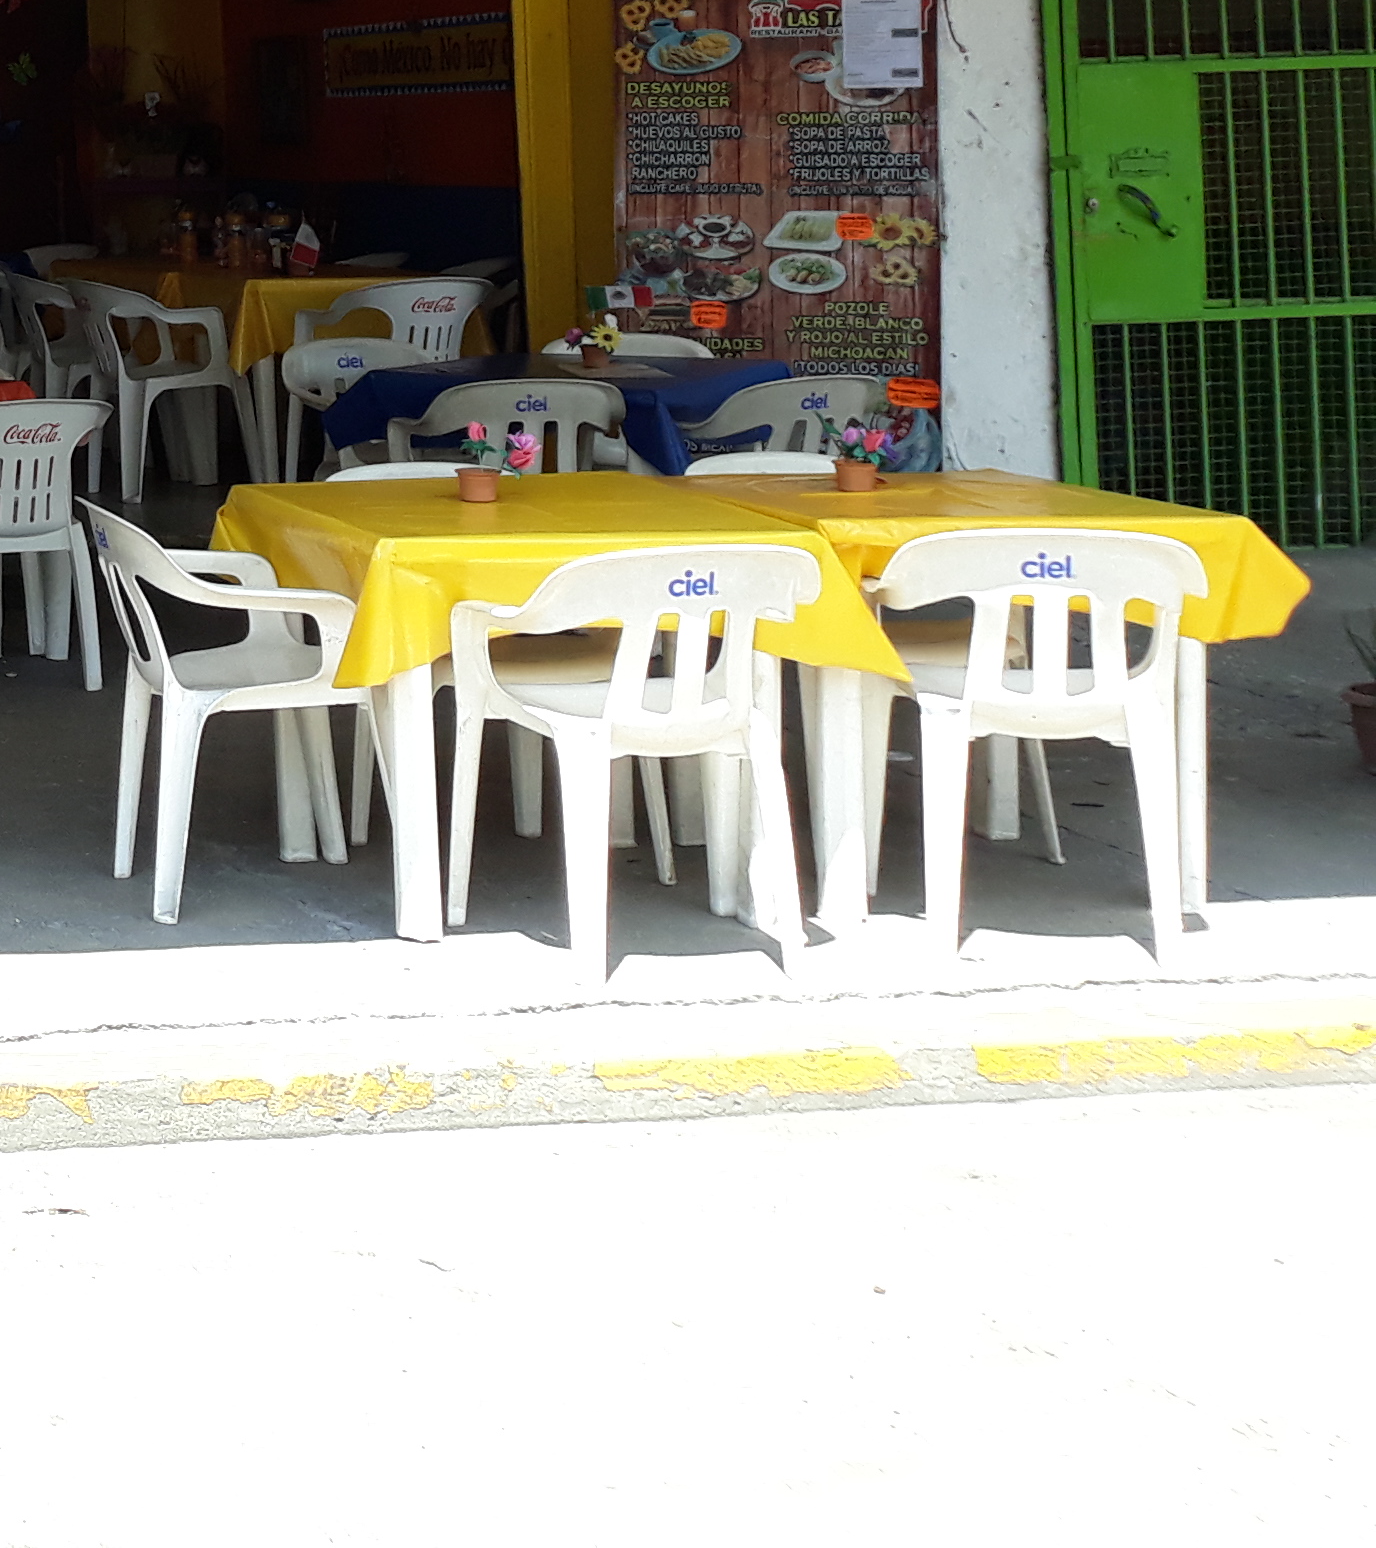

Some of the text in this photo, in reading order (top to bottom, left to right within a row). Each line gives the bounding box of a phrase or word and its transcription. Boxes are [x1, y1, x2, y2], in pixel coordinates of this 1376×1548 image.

[787, 11, 819, 27] LAS
[631, 96, 730, 108] A ESCOGER
[659, 112, 698, 124] CAKES
[777, 112, 923, 124] COMIDA CORRIDA
[683, 126, 697, 138] AL
[700, 126, 741, 138] GUSTO
[828, 127, 845, 139] DE
[848, 127, 886, 139] PASTA
[828, 140, 845, 152] DE
[846, 140, 890, 152] ARROZ
[850, 154, 859, 166] A
[861, 154, 921, 166] ESCOGER
[632, 168, 698, 179] RANCHERO
[852, 168, 862, 180] Y
[865, 168, 930, 180] TORTILLAS
[824, 302, 889, 314] POZOLE
[854, 316, 924, 329] BLANCO
[786, 331, 930, 344] Y ROJO AL ESTILO
[810, 347, 909, 359] MICHOACAN
[851, 362, 878, 374] LOS
[515, 394, 547, 413] ciel
[800, 392, 829, 411] ciel
[4, 422, 62, 446] Coca-Cola
[1020, 552, 1072, 579] ciel
[668, 569, 716, 597] ciel
